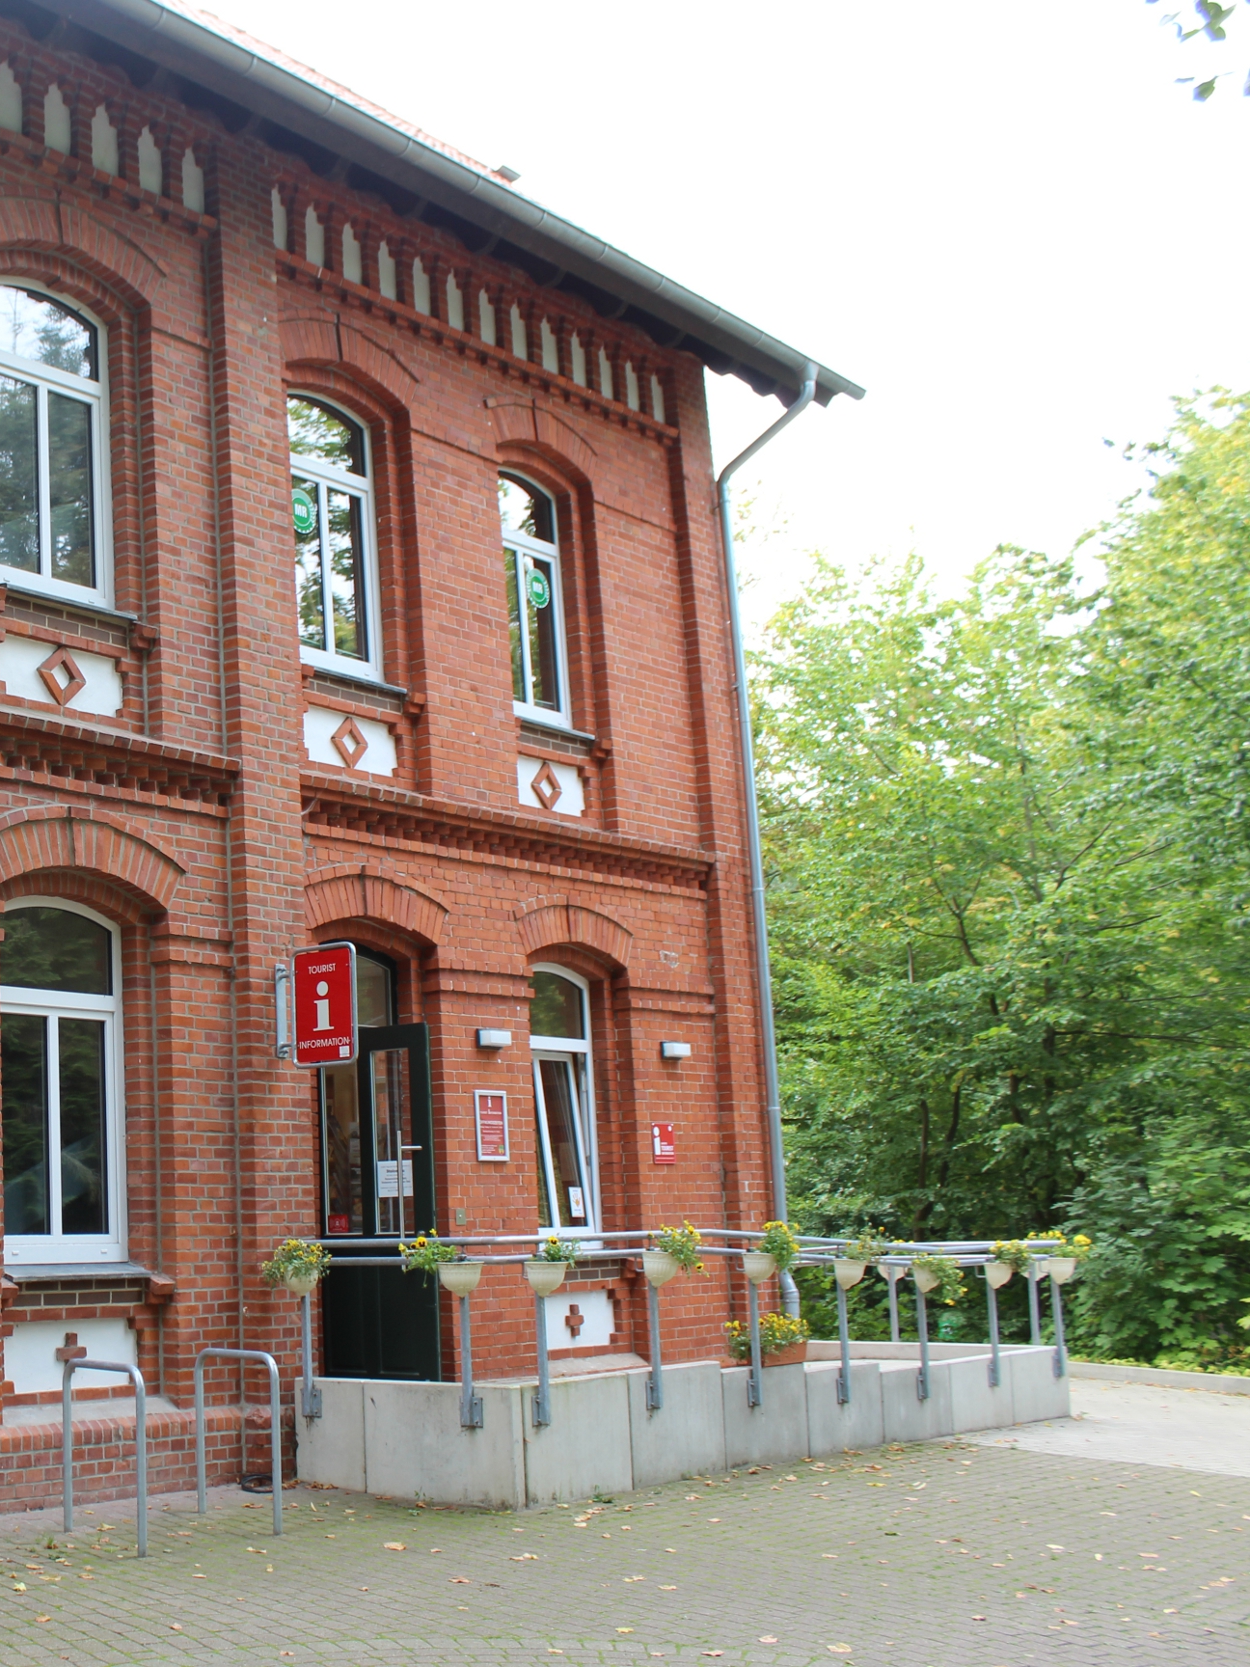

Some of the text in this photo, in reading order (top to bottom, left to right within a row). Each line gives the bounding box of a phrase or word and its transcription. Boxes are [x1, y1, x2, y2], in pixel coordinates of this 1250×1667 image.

[294, 503, 308, 518] MR
[308, 963, 336, 974] TOURIST
[299, 1036, 349, 1049] INFORMATION
